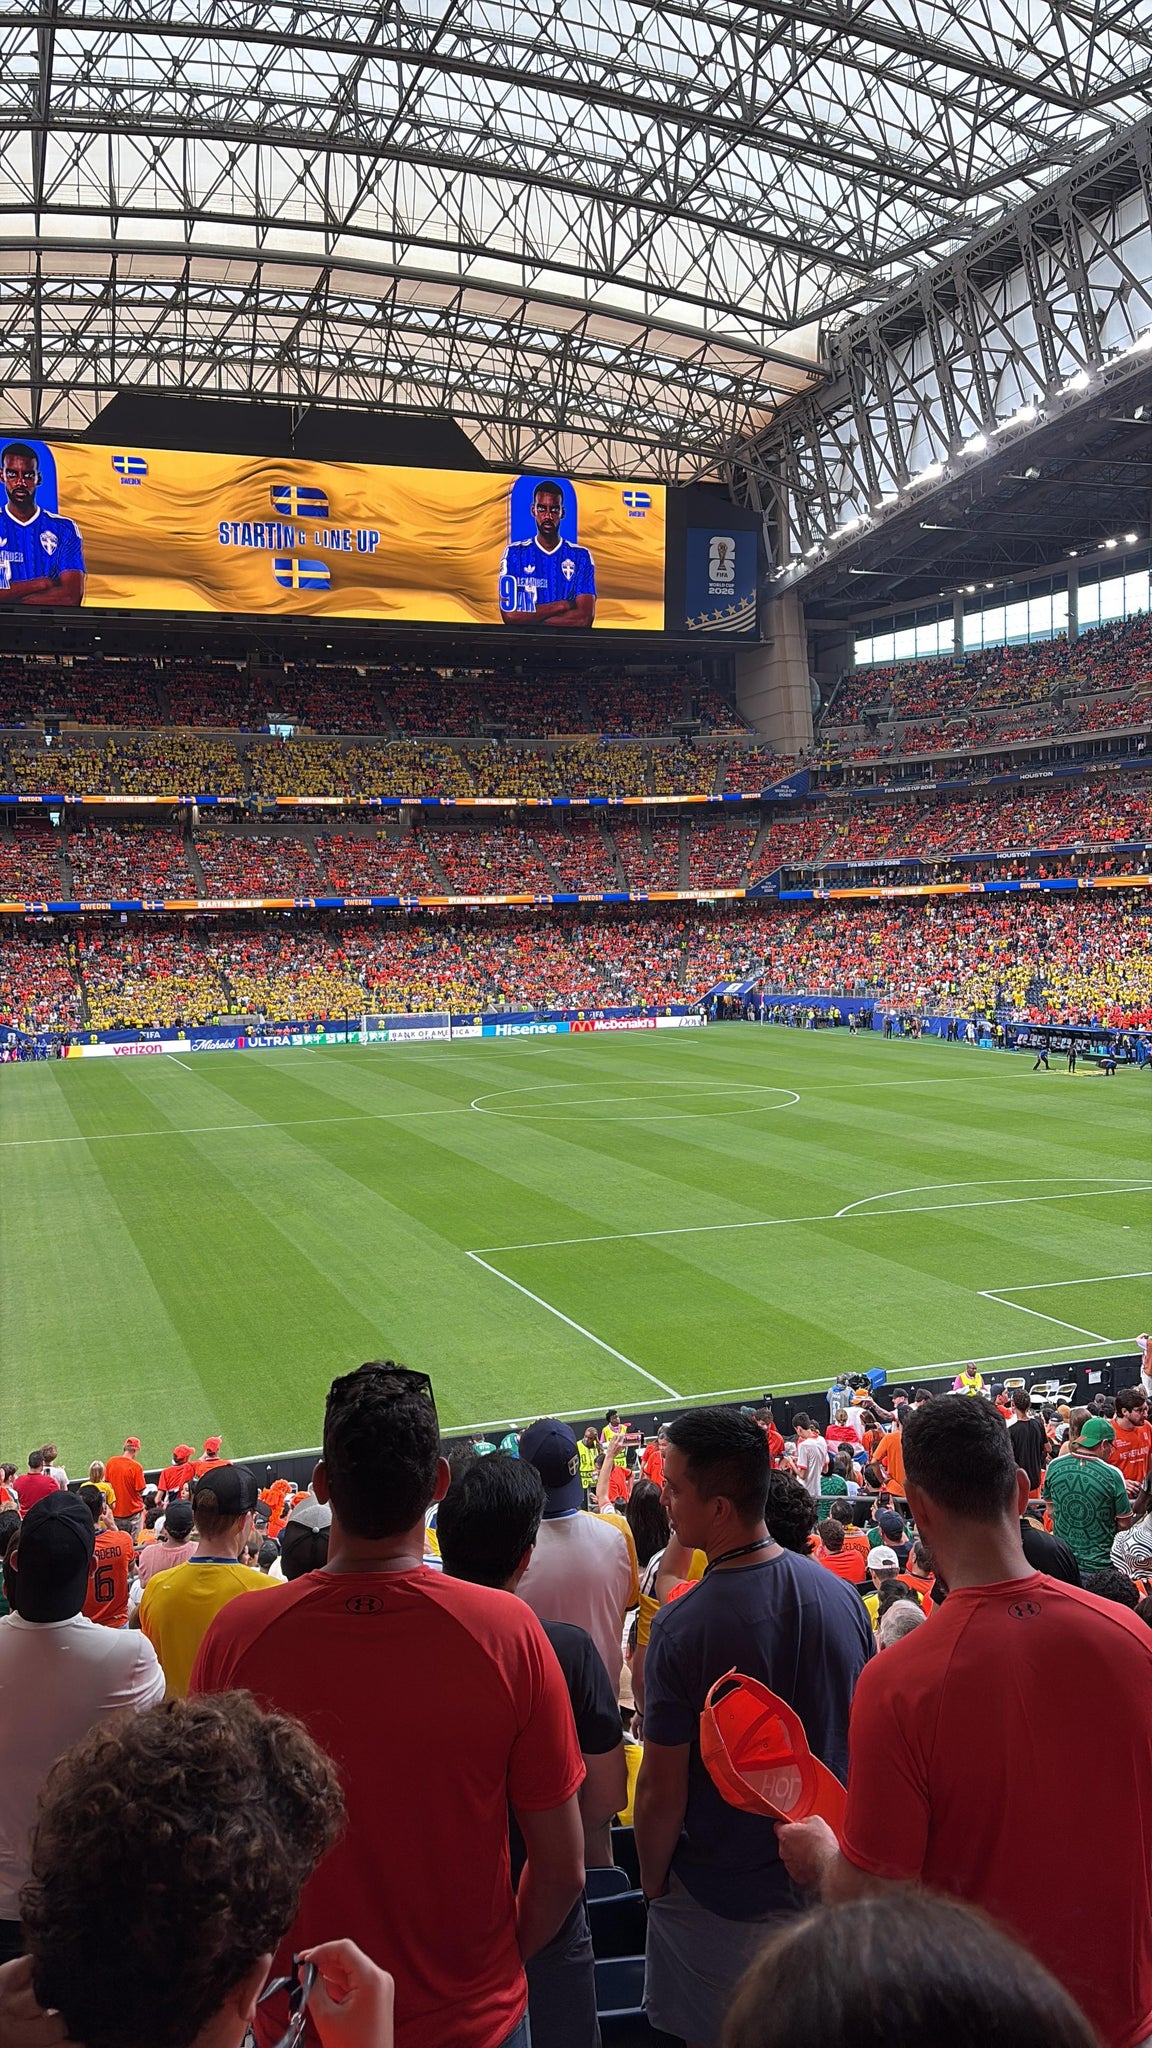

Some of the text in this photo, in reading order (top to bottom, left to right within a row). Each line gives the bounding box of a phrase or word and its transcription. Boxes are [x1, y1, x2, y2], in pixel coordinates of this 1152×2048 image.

[315, 529, 352, 552] LINE
[355, 529, 381, 553] UP
[500, 575, 517, 612] 9
[708, 587, 735, 595] 2026
[1019, 771, 1053, 780] HOUSTON
[495, 1024, 558, 1036] Hisense
[594, 1018, 655, 1031] McDonald's
[392, 1031, 416, 1039] BANK
[430, 1028, 470, 1036] AMERICA
[113, 1043, 163, 1055] verizon
[192, 1038, 236, 1052] Michelob
[248, 1036, 292, 1048] ULTRA
[95, 1565, 114, 1602] 6
